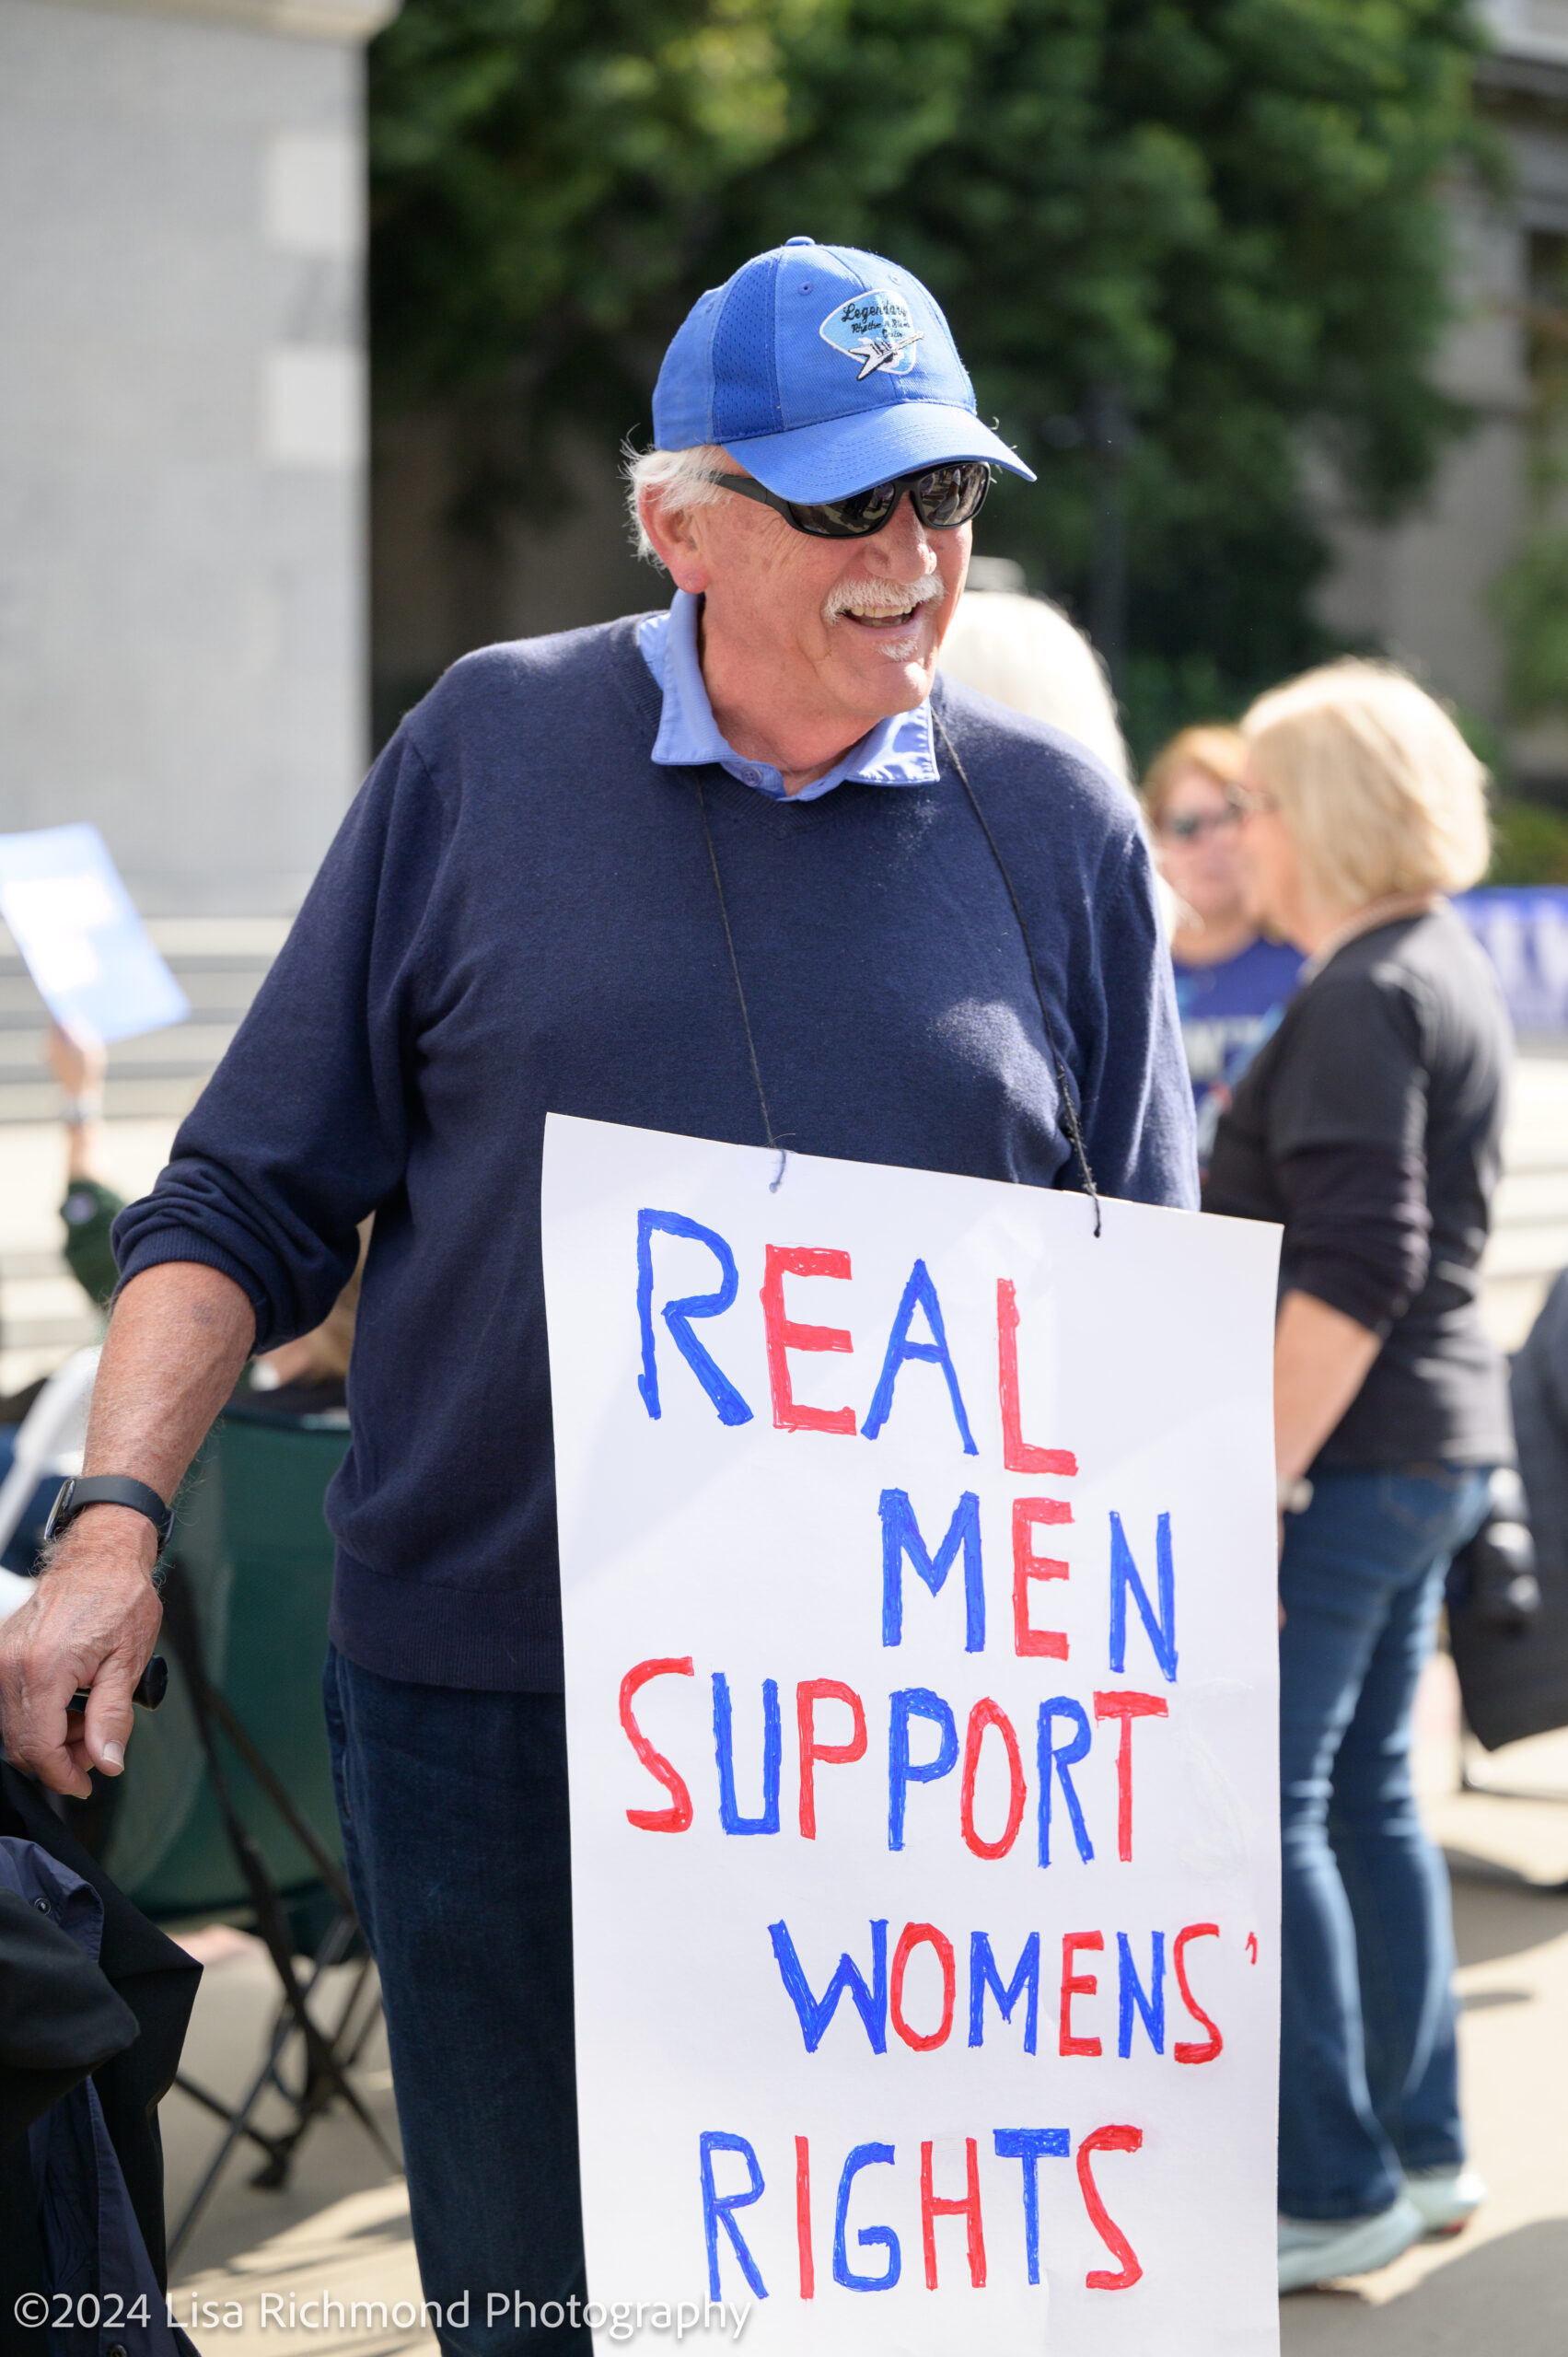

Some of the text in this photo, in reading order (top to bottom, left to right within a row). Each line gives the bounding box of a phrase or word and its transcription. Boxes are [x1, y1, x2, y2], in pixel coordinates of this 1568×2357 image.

[841, 300, 907, 323] Legendary
[636, 1208, 1078, 1476] REAL
[877, 1488, 1179, 1684] MEN
[619, 1656, 1168, 1869] SUPPORT
[767, 1919, 1259, 2064] WOMENS'
[700, 2124, 1143, 2302] RIGHTS
